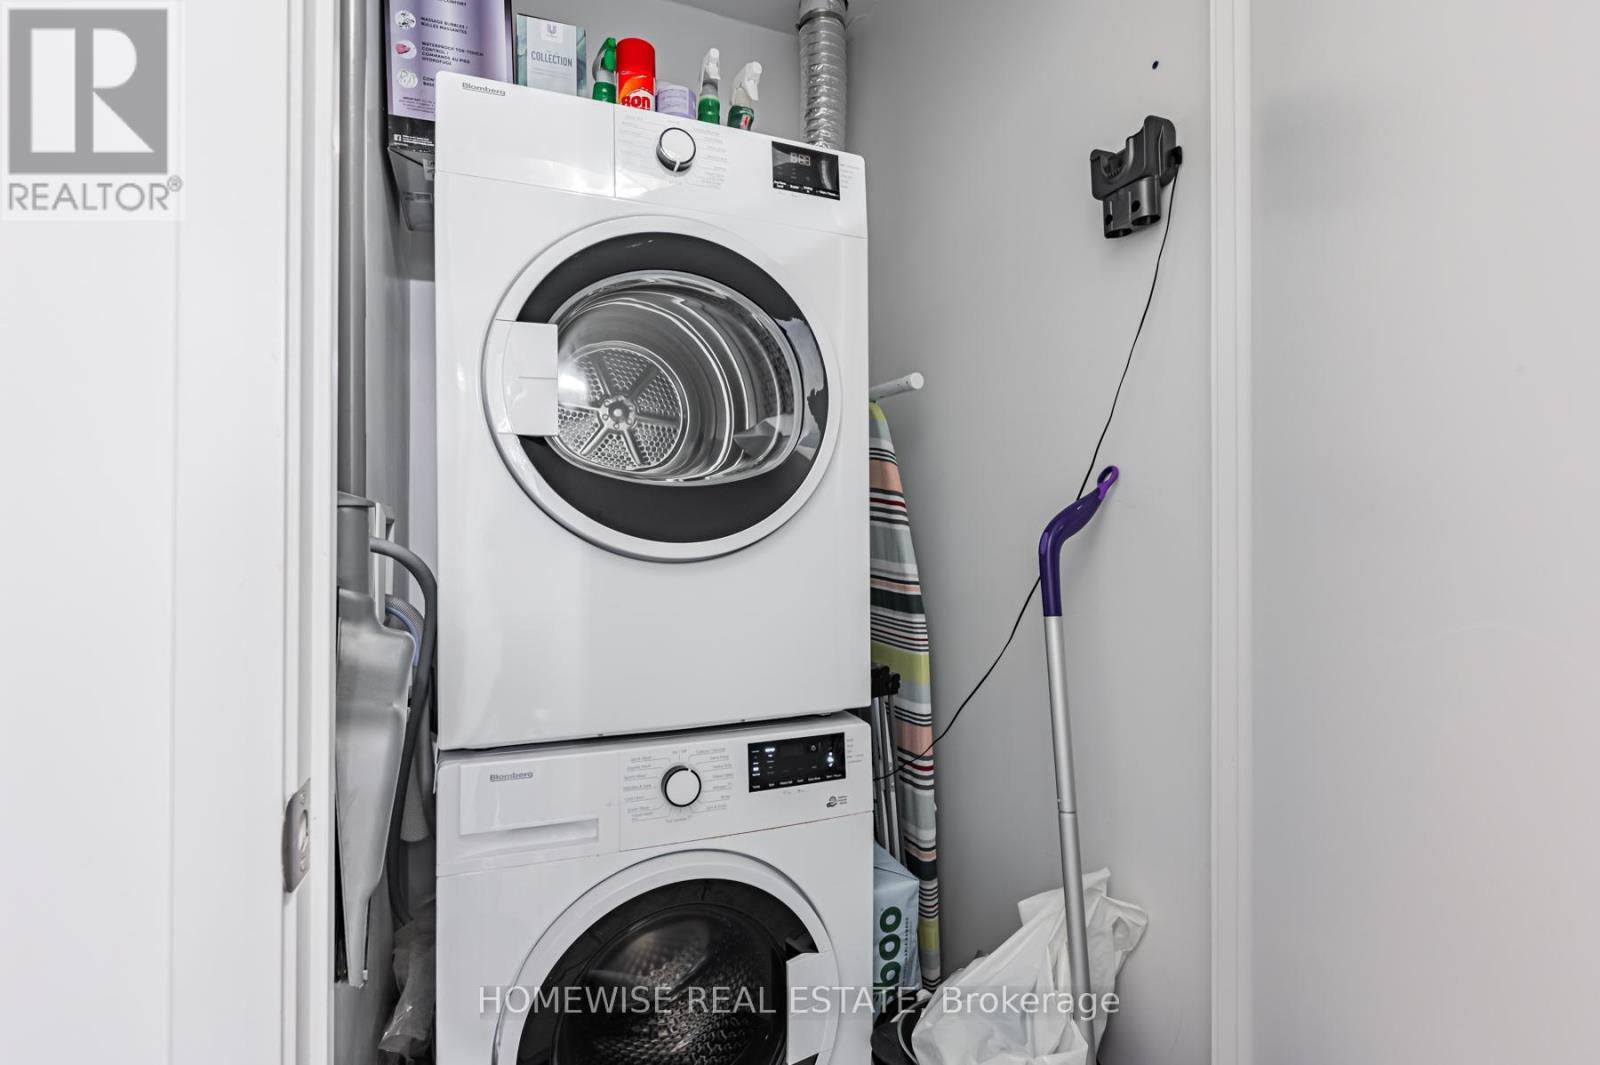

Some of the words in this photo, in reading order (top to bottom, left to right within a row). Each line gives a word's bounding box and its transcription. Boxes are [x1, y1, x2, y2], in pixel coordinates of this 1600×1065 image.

[530, 50, 573, 67] COLLECTION
[462, 81, 506, 96] Blomberg
[489, 771, 534, 783] Blomberg
